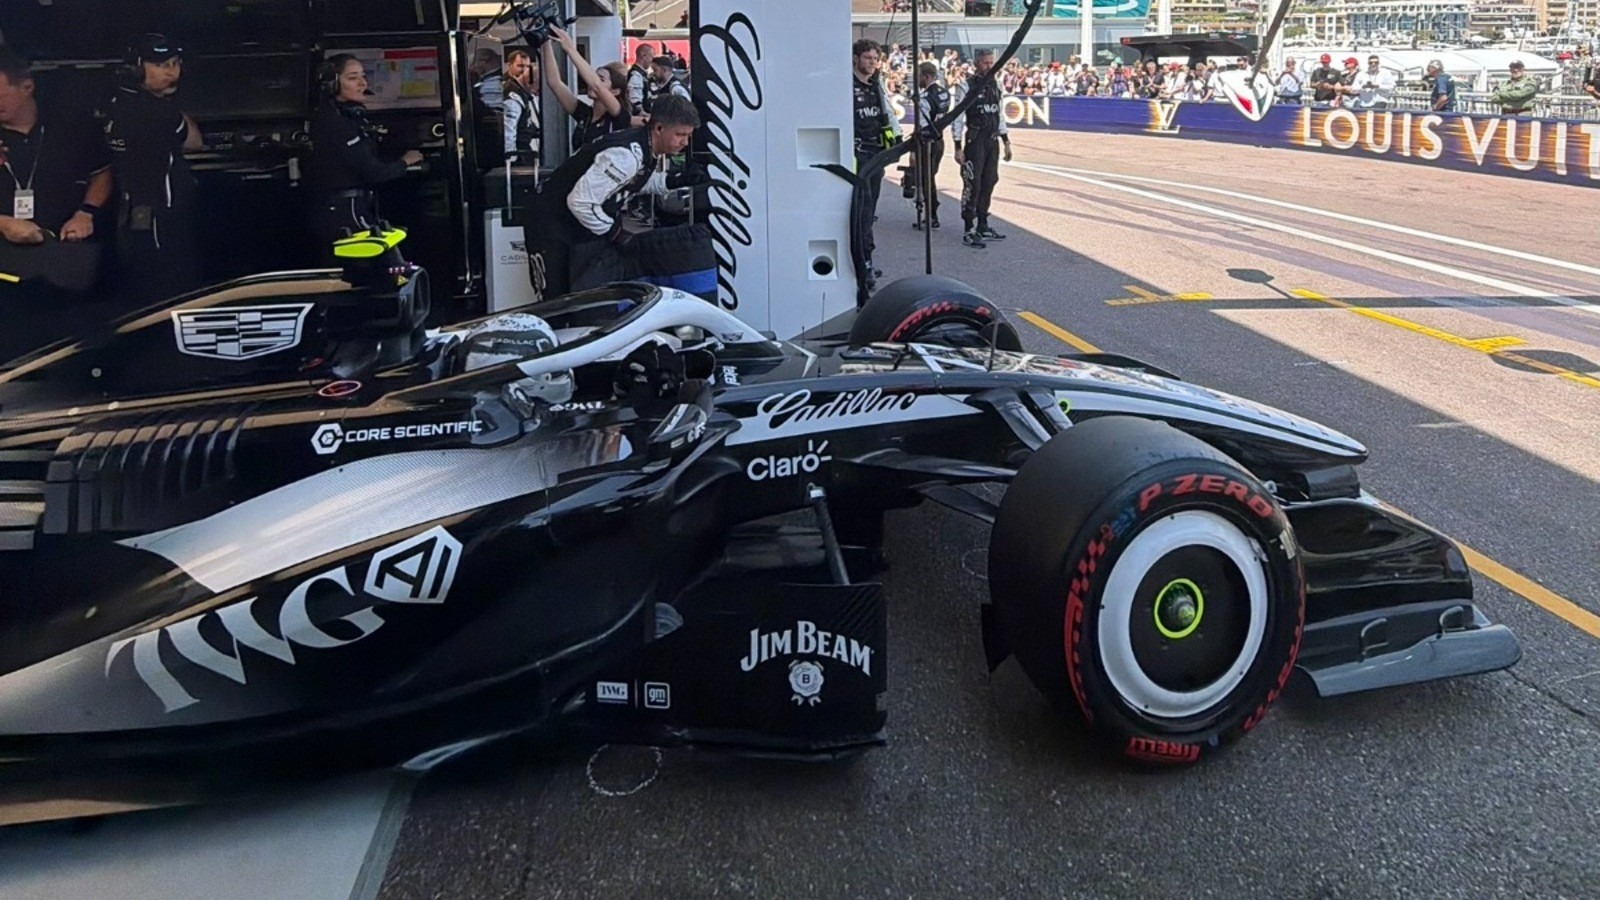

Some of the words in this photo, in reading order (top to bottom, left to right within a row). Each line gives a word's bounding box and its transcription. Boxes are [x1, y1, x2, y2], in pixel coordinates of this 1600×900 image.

[1303, 107, 1443, 160] LOUIS
[699, 12, 762, 311] Cadillac
[490, 338, 534, 346] CADILLAC
[757, 387, 917, 429] Cadillac
[345, 427, 391, 443] CORE
[394, 420, 483, 439] SCIENTIFIC
[747, 453, 821, 481] Claro
[1138, 482, 1162, 511] P
[1172, 473, 1273, 518] ZERO
[105, 566, 386, 713] TWG
[741, 628, 792, 671] JIM
[797, 620, 871, 677] BEAM
[601, 684, 626, 696] TWG
[648, 688, 666, 703] gm
